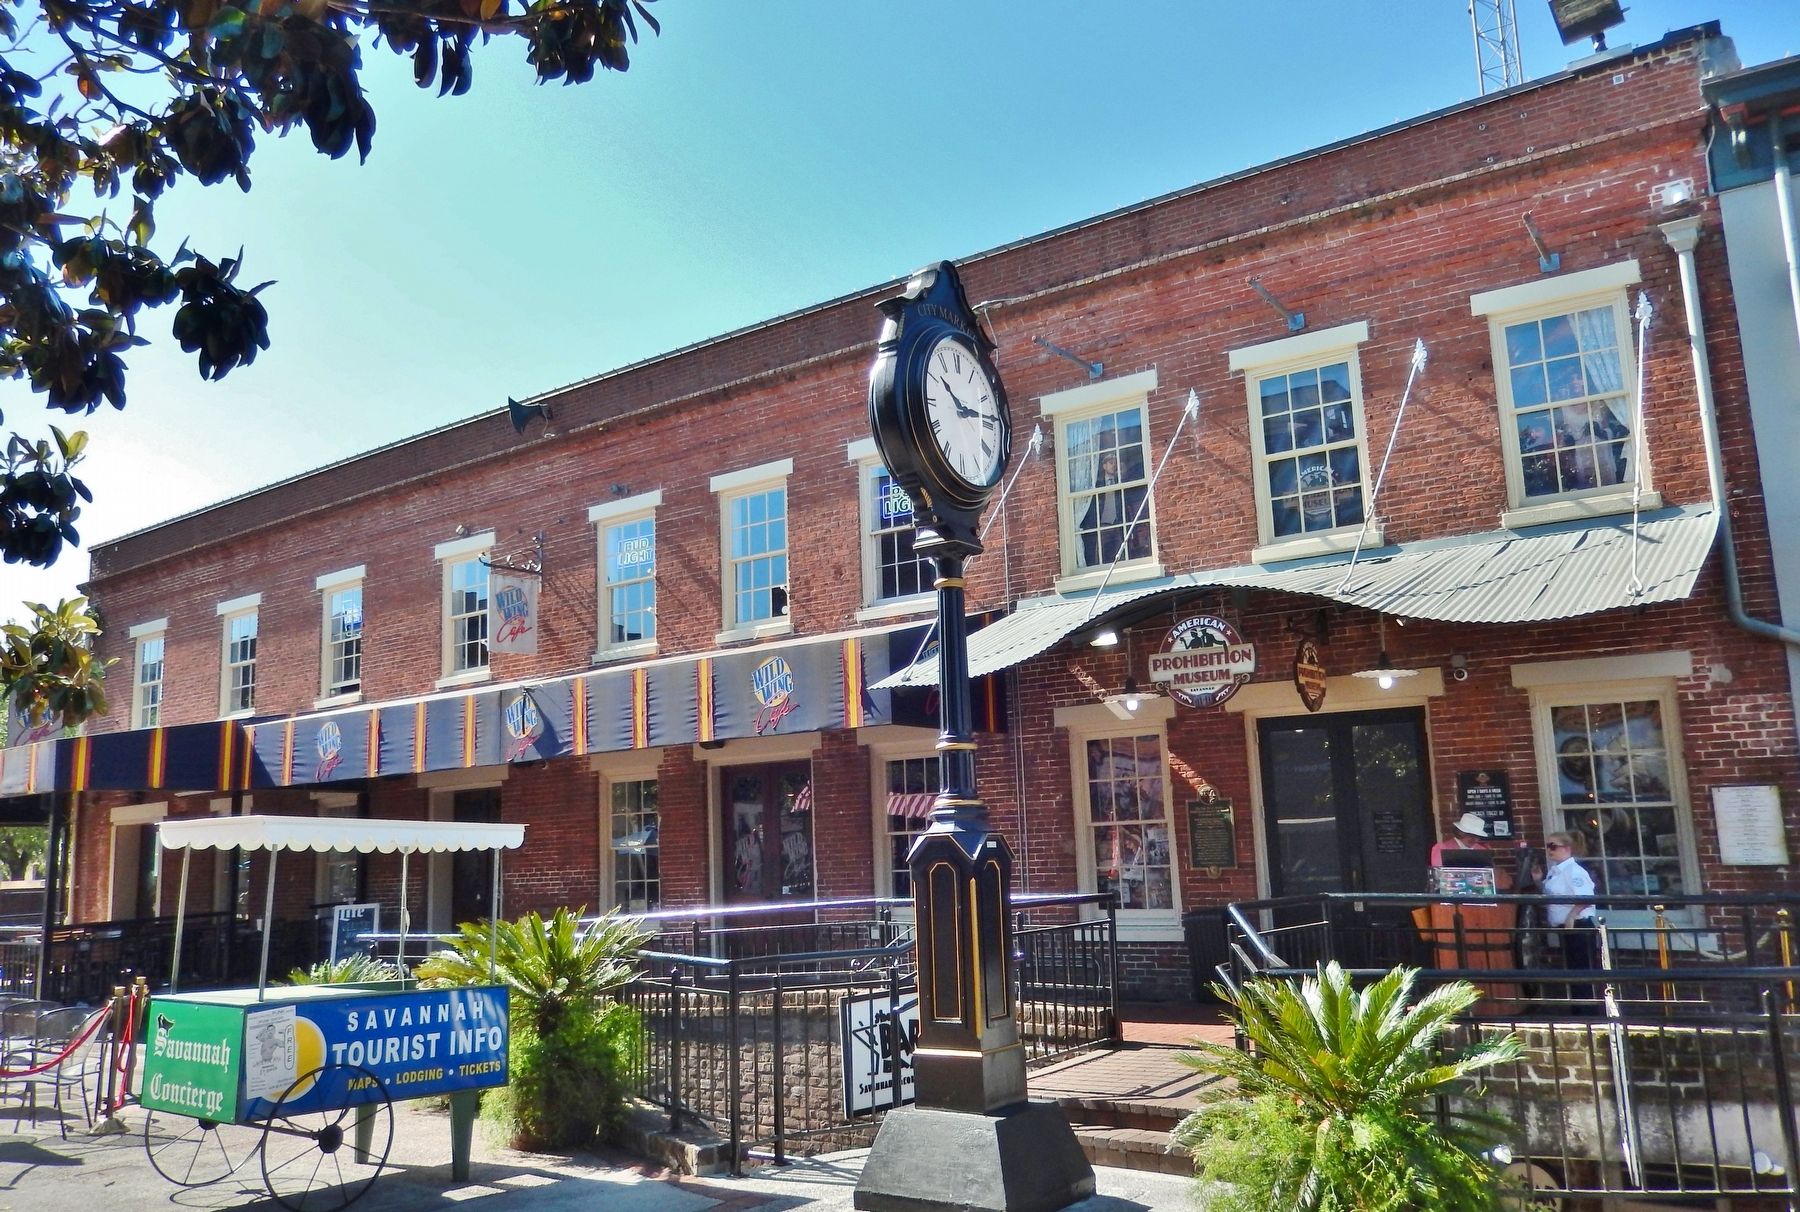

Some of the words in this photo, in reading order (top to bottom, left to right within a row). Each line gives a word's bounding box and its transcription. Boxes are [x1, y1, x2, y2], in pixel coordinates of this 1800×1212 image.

[917, 304, 937, 317] CITY
[618, 549, 652, 566] LIGHT
[624, 538, 649, 553] BUD
[496, 587, 524, 611] WILD
[502, 601, 528, 621] WING
[497, 615, 532, 643] Cafe
[1172, 618, 1226, 639] AMERICAN
[1152, 648, 1252, 672] PROHIBITION
[752, 656, 785, 692] WILD
[1173, 669, 1231, 685] MUSEUM
[760, 672, 793, 704] WING
[756, 690, 800, 735] Cafe
[317, 721, 338, 746] WILD
[347, 1000, 484, 1032] SAVANNAH
[153, 1027, 231, 1073] Savannah
[332, 1032, 441, 1069] TOURIST
[450, 1026, 502, 1056] INFO
[347, 1076, 378, 1090] MAPS
[396, 1068, 443, 1085] LODGING
[459, 1061, 501, 1077] TICKETS
[150, 1072, 224, 1117] Concierge
